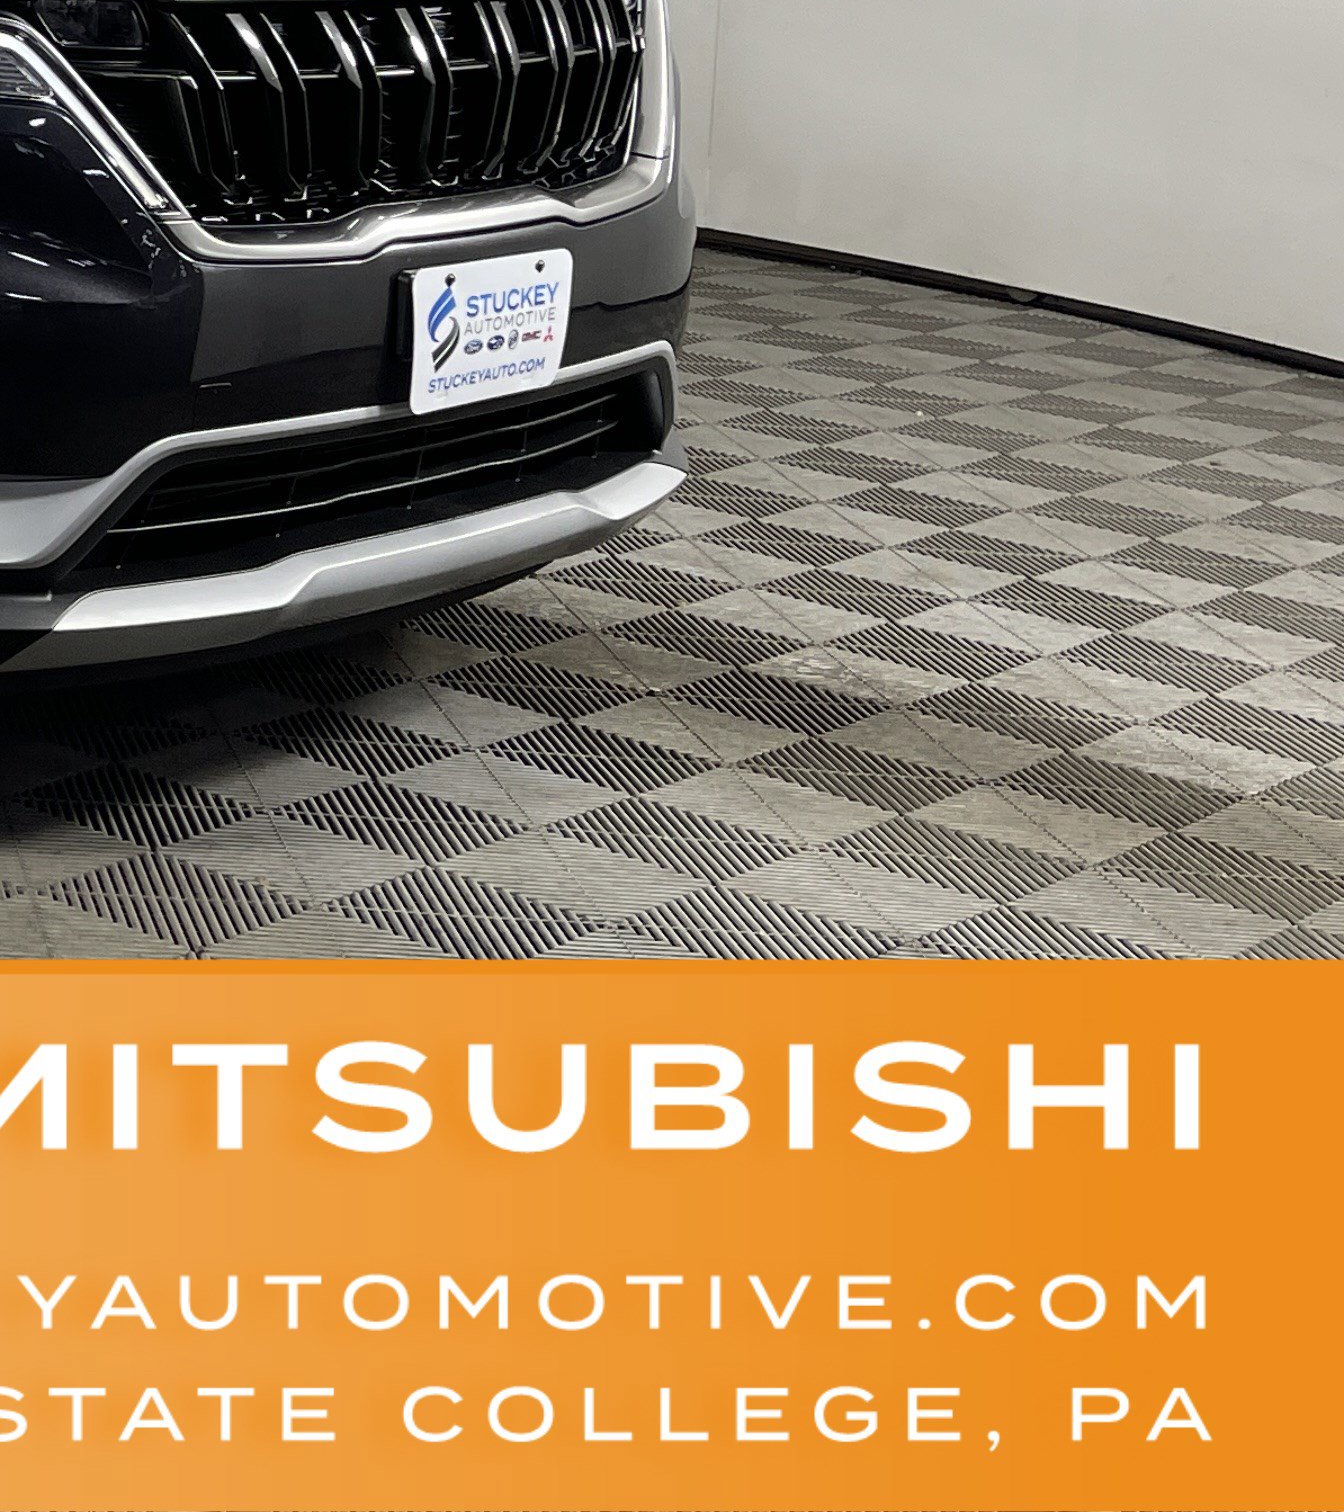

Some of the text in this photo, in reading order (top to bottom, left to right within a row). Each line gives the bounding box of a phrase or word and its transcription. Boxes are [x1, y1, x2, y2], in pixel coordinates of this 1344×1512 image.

[466, 282, 559, 317] STUCKEY
[464, 307, 555, 335] AUTOMOTIVE
[428, 357, 545, 393] STUCKEYAUTO.COM
